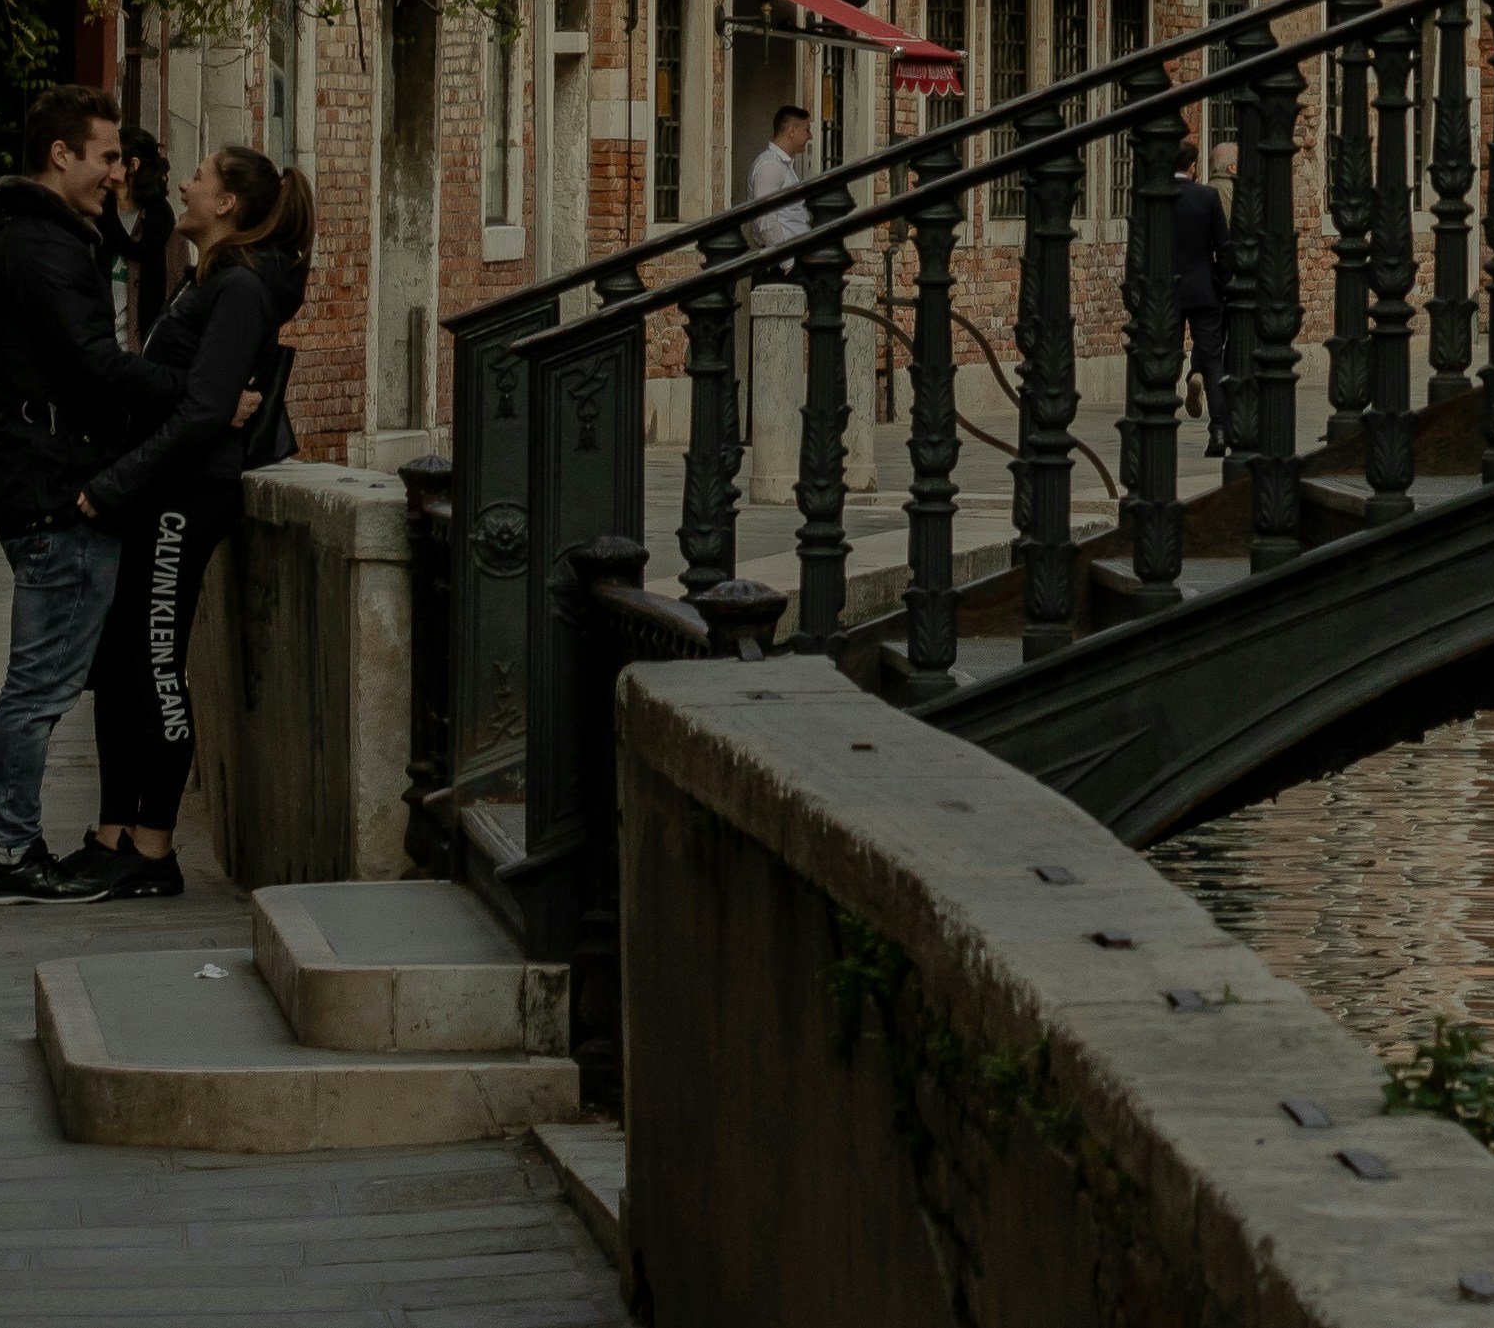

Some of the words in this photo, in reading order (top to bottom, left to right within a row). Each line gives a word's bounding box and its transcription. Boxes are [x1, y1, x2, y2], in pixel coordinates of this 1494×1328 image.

[152, 511, 187, 595] CALVIN
[150, 599, 175, 665] KLEIN
[153, 665, 190, 742] JEANS
